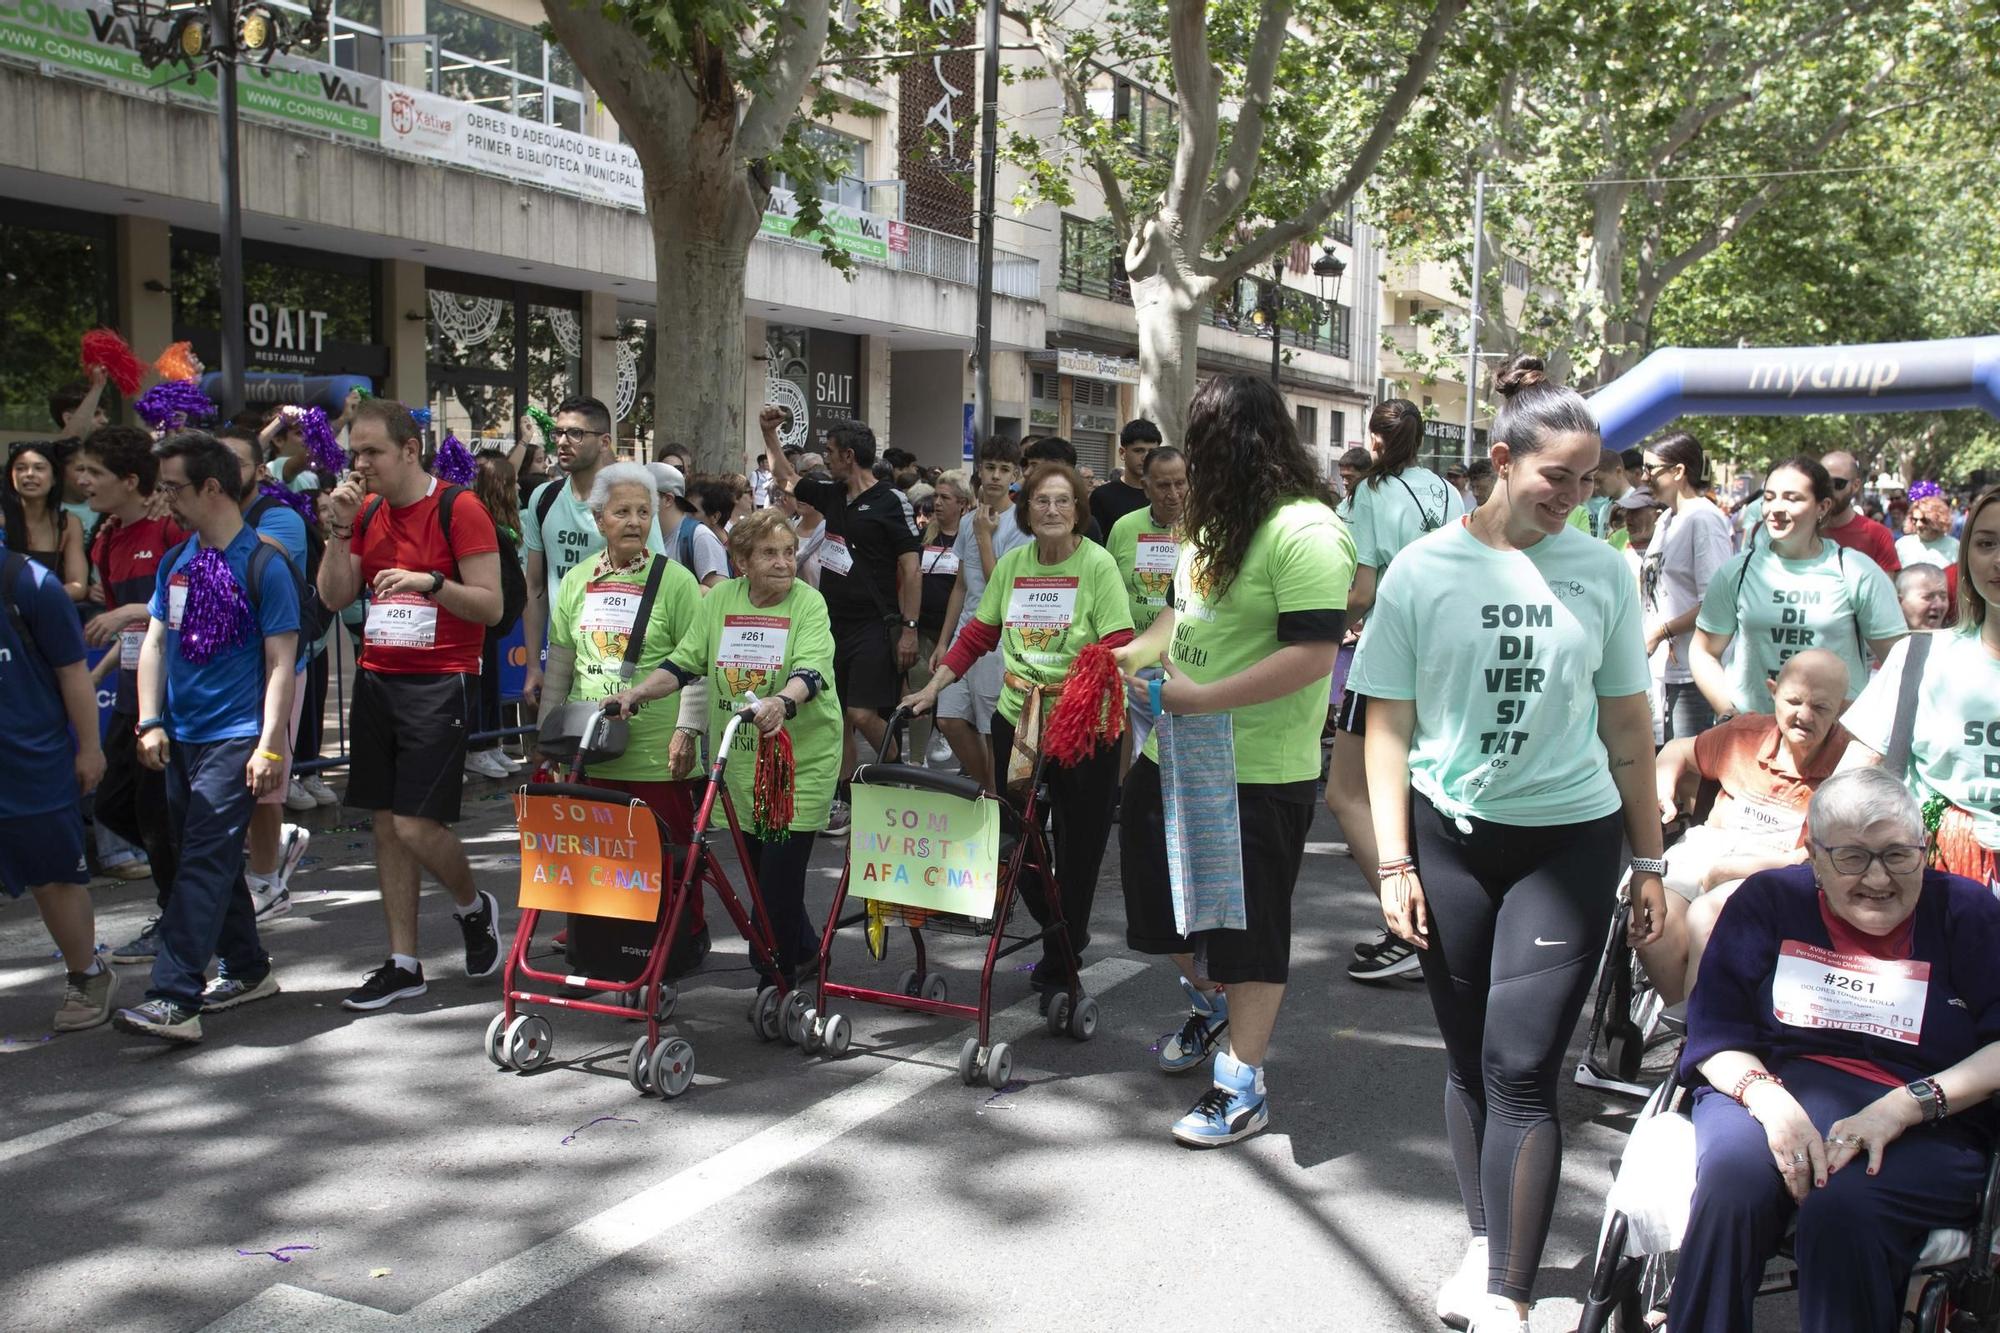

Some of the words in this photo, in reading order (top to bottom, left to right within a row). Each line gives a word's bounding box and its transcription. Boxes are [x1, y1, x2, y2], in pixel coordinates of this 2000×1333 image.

[246, 90, 368, 130] WWW.CONSVAL.ES
[467, 113, 506, 135] OBRES
[511, 125, 584, 155] D'ADEQUACIÓ
[588, 145, 600, 160] DE
[604, 150, 621, 163] LA
[621, 155, 642, 170] PLA
[467, 134, 511, 156] PRIMER
[517, 146, 580, 174] BIBLIOTECA
[584, 164, 637, 188] MUNICIPAL
[249, 303, 328, 352] SAIT
[255, 352, 316, 365] RESTAURANT
[1748, 353, 1900, 398] mychip
[816, 371, 853, 404] SAIT
[816, 408, 822, 418] A
[827, 409, 852, 420] CASA
[558, 530, 589, 547] SOM
[564, 549, 580, 563] DI
[603, 597, 626, 607] #261
[1028, 593, 1059, 602] #1005
[1136, 596, 1148, 605] AFA
[1175, 598, 1187, 613] AFA
[1773, 590, 1821, 604] SOM
[386, 609, 412, 619] #261
[1481, 604, 1553, 629] SOM
[1782, 609, 1806, 624] DI
[386, 639, 427, 647] DIVERSITAT
[741, 632, 765, 641] #261
[1771, 628, 1815, 646] VER
[1499, 636, 1533, 660] DI
[587, 665, 604, 675] AFA
[737, 662, 777, 670] DIVERSITAT
[1484, 668, 1546, 693] VER
[718, 699, 732, 712] AFA
[1496, 700, 1526, 725] SI
[1480, 731, 1529, 755] TAT
[552, 803, 614, 825] SOM
[885, 808, 948, 832] SOM
[1744, 806, 1779, 825] #1005
[524, 831, 638, 859] DIVERSITAT
[855, 832, 979, 861] DIVERSITAT
[533, 863, 574, 886] AFA
[589, 865, 661, 893] CANALS
[863, 862, 910, 885] AFA
[924, 866, 994, 890] CANALS
[1796, 948, 1827, 963] Persones
[1823, 972, 1876, 995] #261
[1801, 983, 1836, 996] DOLORES
[1869, 997, 1896, 1008] MOLLA
[1817, 1017, 1904, 1040] DIVERSITAT
